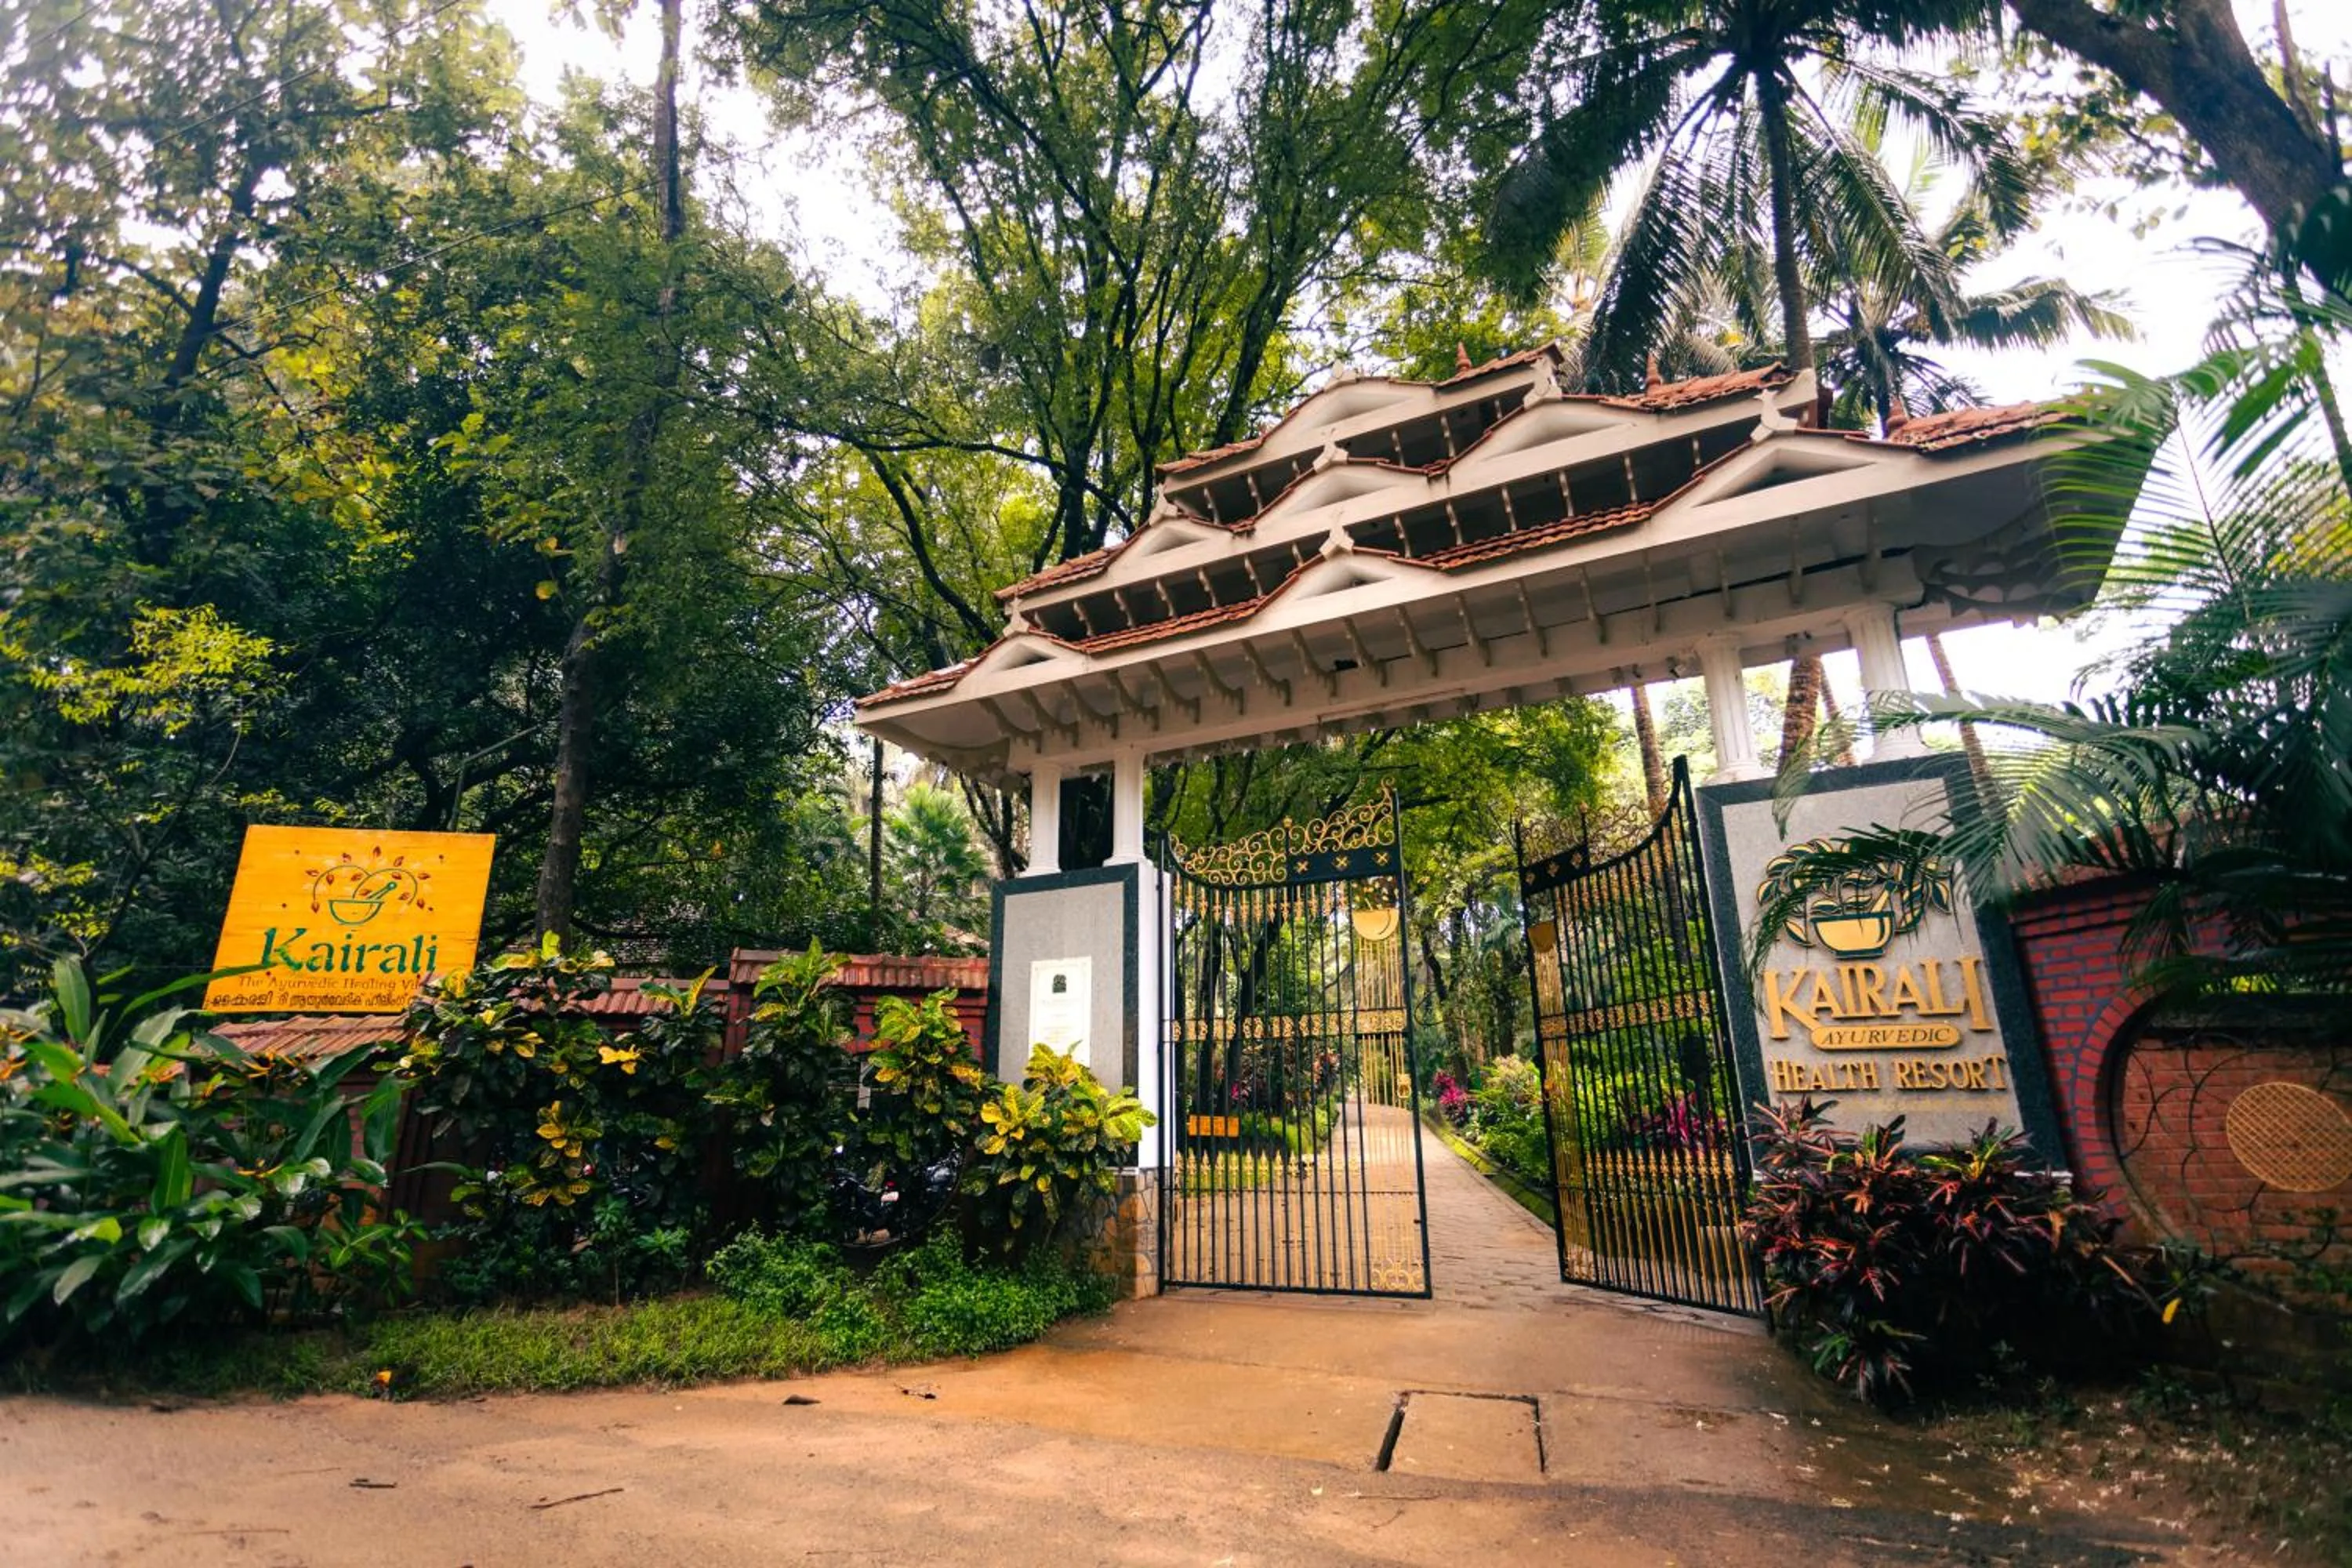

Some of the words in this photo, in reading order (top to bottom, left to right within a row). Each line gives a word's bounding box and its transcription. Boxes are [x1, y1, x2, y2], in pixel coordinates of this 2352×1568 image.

[261, 927, 438, 974] Kairali
[270, 975, 339, 992] Ayurvedic
[343, 978, 396, 993] Healing
[1764, 957, 1994, 1040] KAIRALI
[1820, 1027, 1951, 1046] AYURVEDIC
[1772, 1058, 1879, 1092] HEALTH
[1893, 1053, 2008, 1091] RESORT
